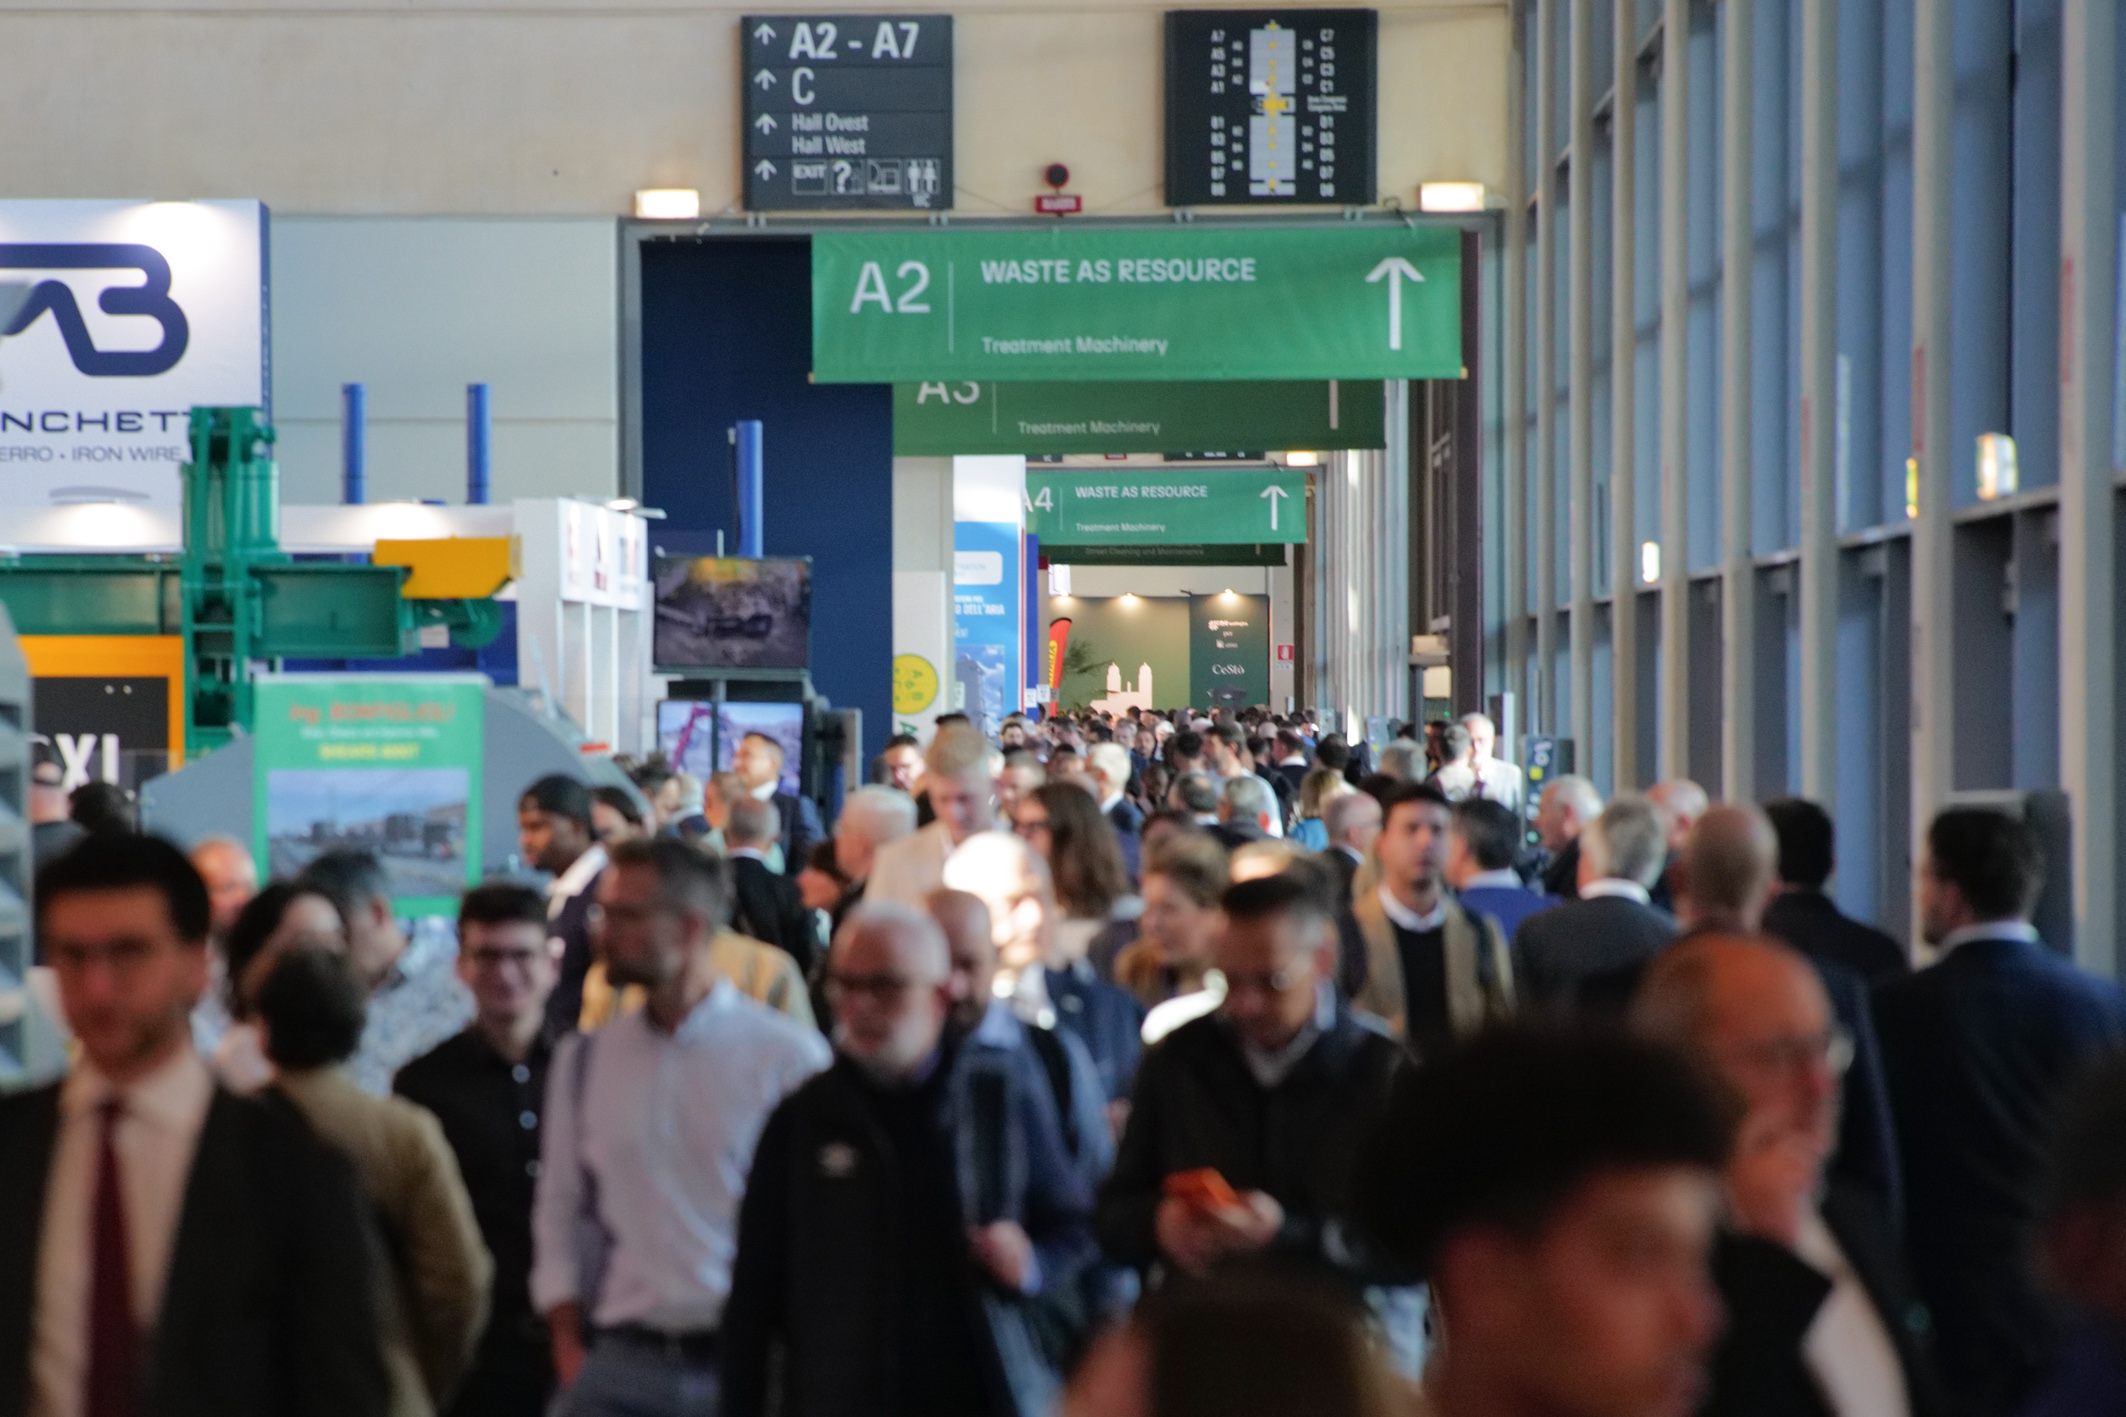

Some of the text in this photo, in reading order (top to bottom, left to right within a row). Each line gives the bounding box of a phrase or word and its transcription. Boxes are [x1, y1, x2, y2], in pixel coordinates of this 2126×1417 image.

[789, 21, 920, 60] A2 - A7
[792, 67, 815, 105] C
[792, 112, 869, 131] Hall Ovest
[792, 135, 866, 154] Hall West
[793, 163, 827, 179] EXIT
[850, 257, 1257, 314] A2 WASTE AS RESOURCE
[981, 335, 1169, 357] Treatment Machinery
[1017, 420, 1161, 436] Treatment Machinery
[71, 446, 123, 462] IRON
[129, 446, 182, 462] WIRE
[1075, 486, 1119, 499] WASTE
[1121, 486, 1138, 499] AS
[1141, 485, 1209, 499] RESOURCE
[1075, 522, 1166, 534] Treatment Machinery
